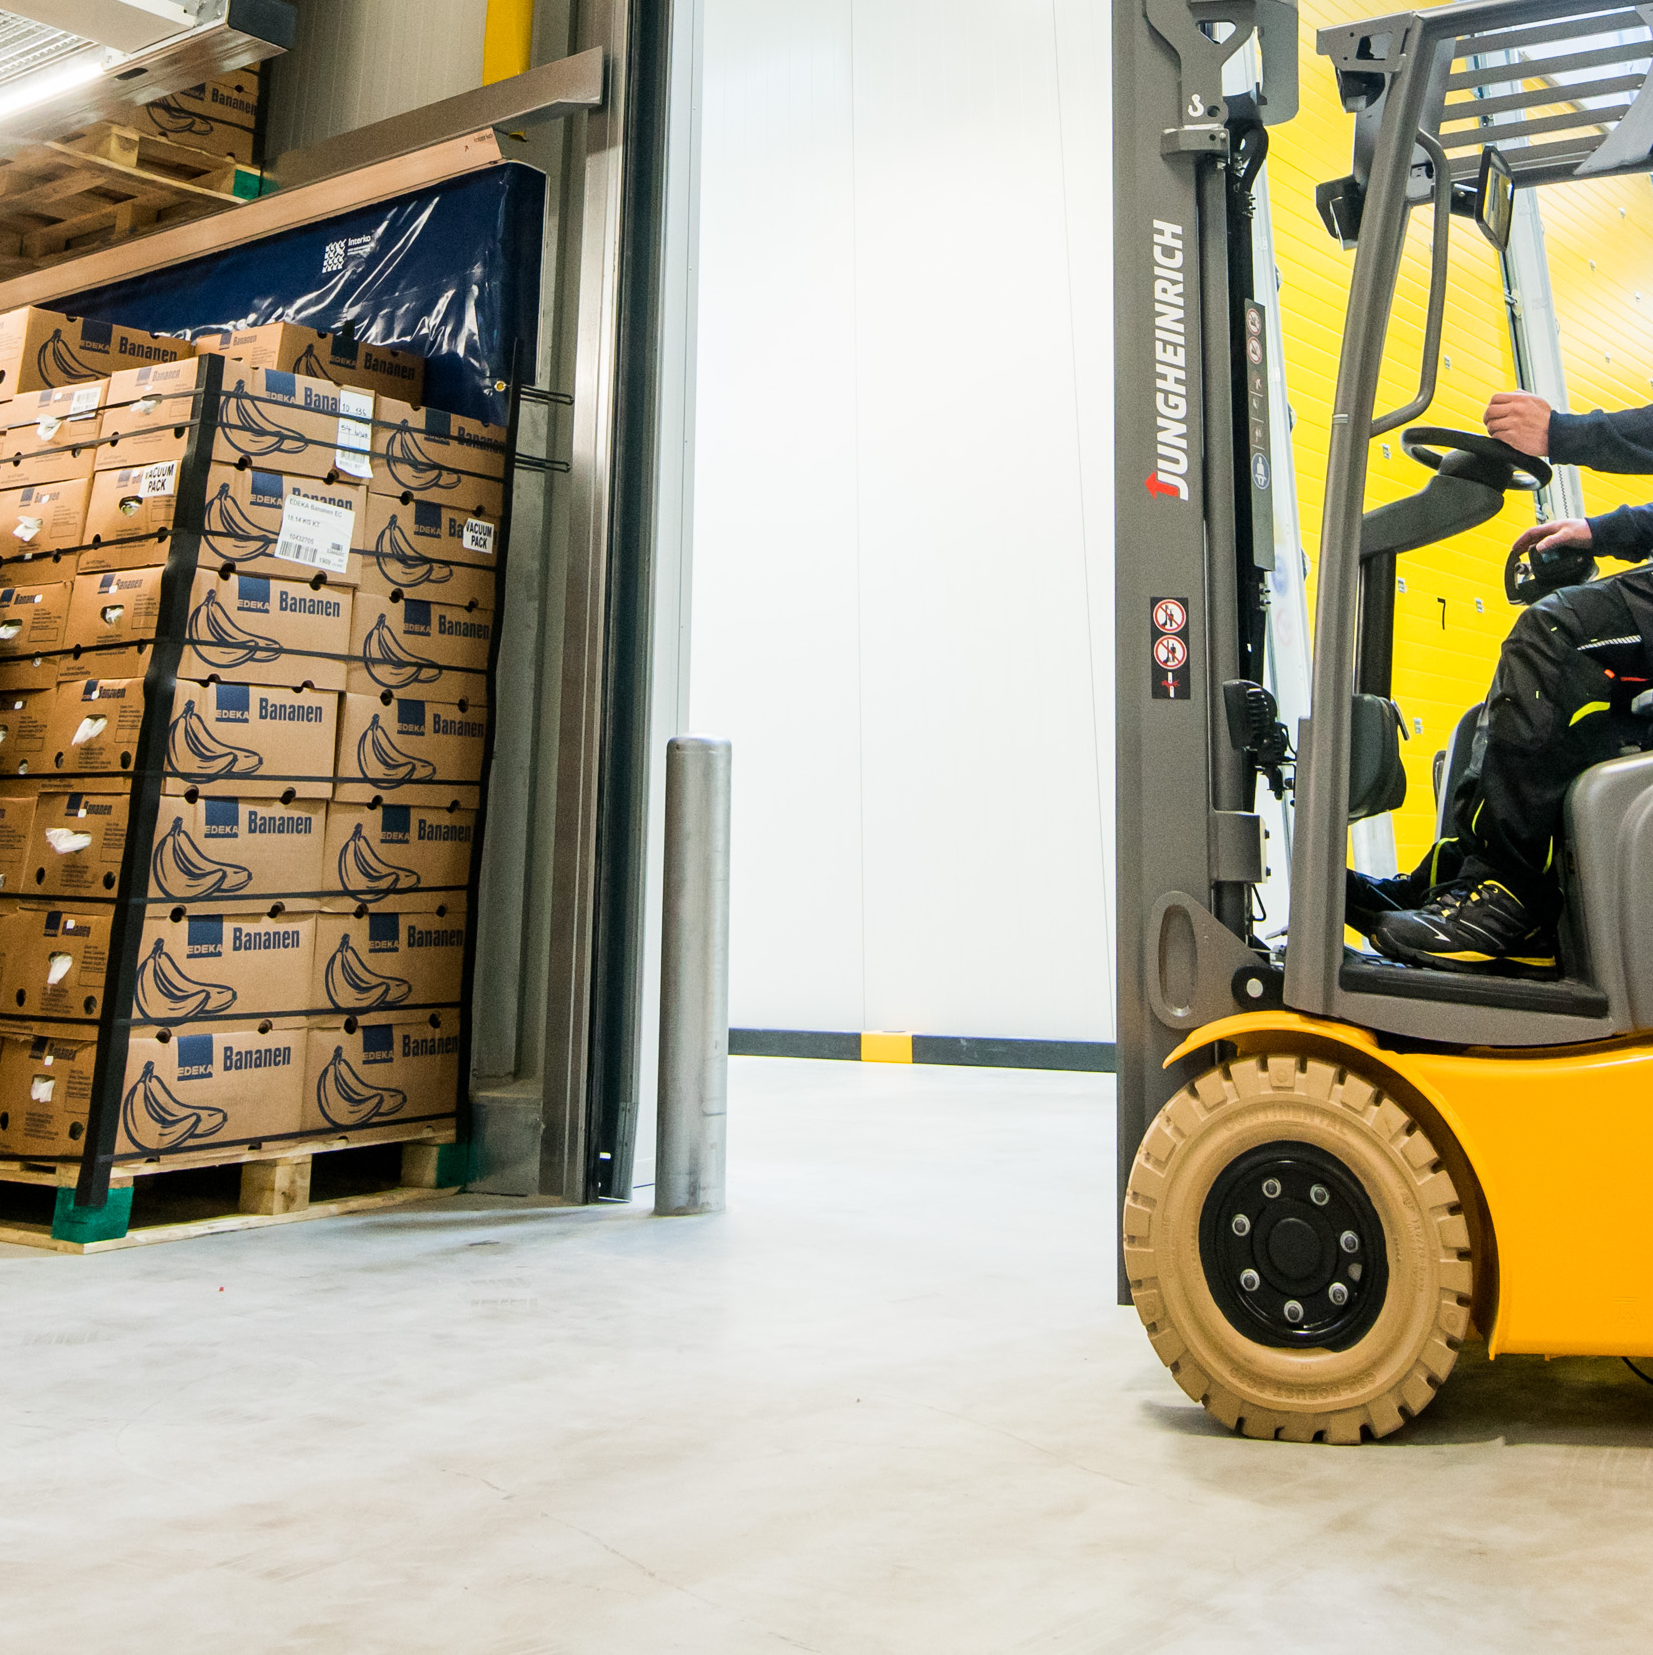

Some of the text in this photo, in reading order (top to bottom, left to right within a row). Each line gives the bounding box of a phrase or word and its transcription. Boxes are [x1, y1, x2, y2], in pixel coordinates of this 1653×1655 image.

[348, 235, 371, 246] Interko
[119, 336, 177, 362] Bananen
[1152, 219, 1189, 501] JUNGHEINRICH
[364, 352, 415, 380] Bananen
[147, 479, 166, 493] PACK
[251, 494, 282, 506] EDEKA
[290, 499, 309, 509] EDEKA
[466, 521, 492, 538] VACUUM
[471, 535, 487, 549] PACK
[238, 591, 340, 618] EDEKA Bananen
[439, 614, 489, 640] Bananen
[216, 697, 323, 723] EDEKA Bananen
[433, 713, 484, 737] Bananen
[204, 810, 312, 835] EDEKA Bananen
[418, 819, 471, 842] Bananen
[187, 926, 300, 954] EDEKA Bananen
[408, 925, 463, 948] Bananen
[402, 1034, 459, 1058] Bananen
[177, 1043, 292, 1077] EDEKA Bananen
